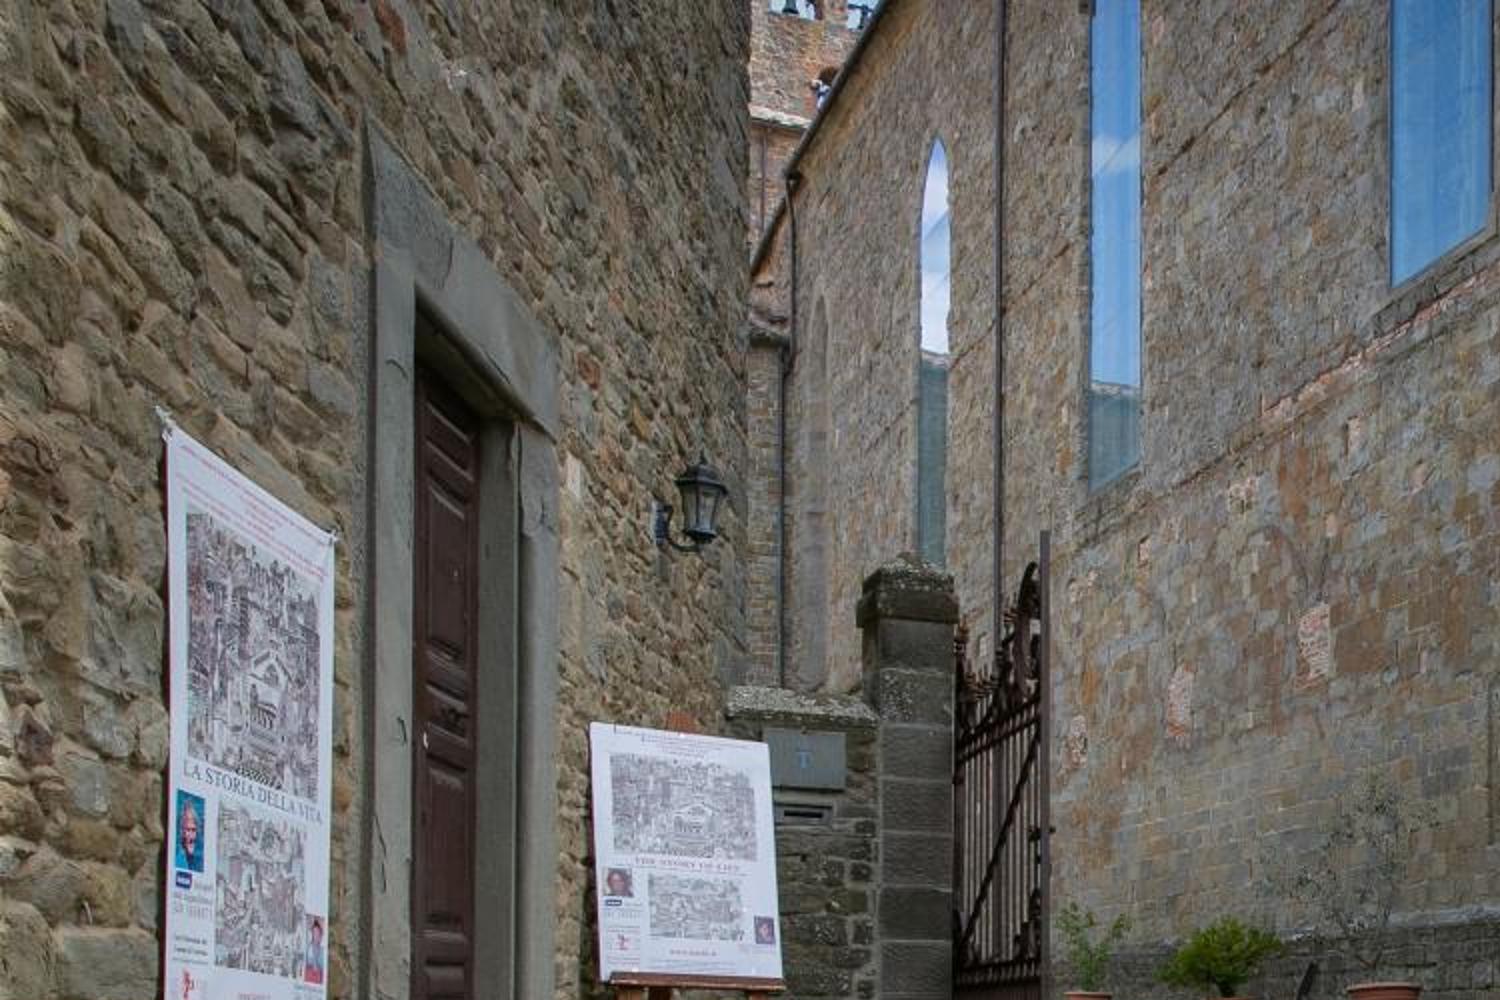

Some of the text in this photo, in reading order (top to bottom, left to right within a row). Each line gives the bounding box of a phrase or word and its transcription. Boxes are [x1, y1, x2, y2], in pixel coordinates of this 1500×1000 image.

[184, 759, 322, 825] LA STORIA DELLA VITA
